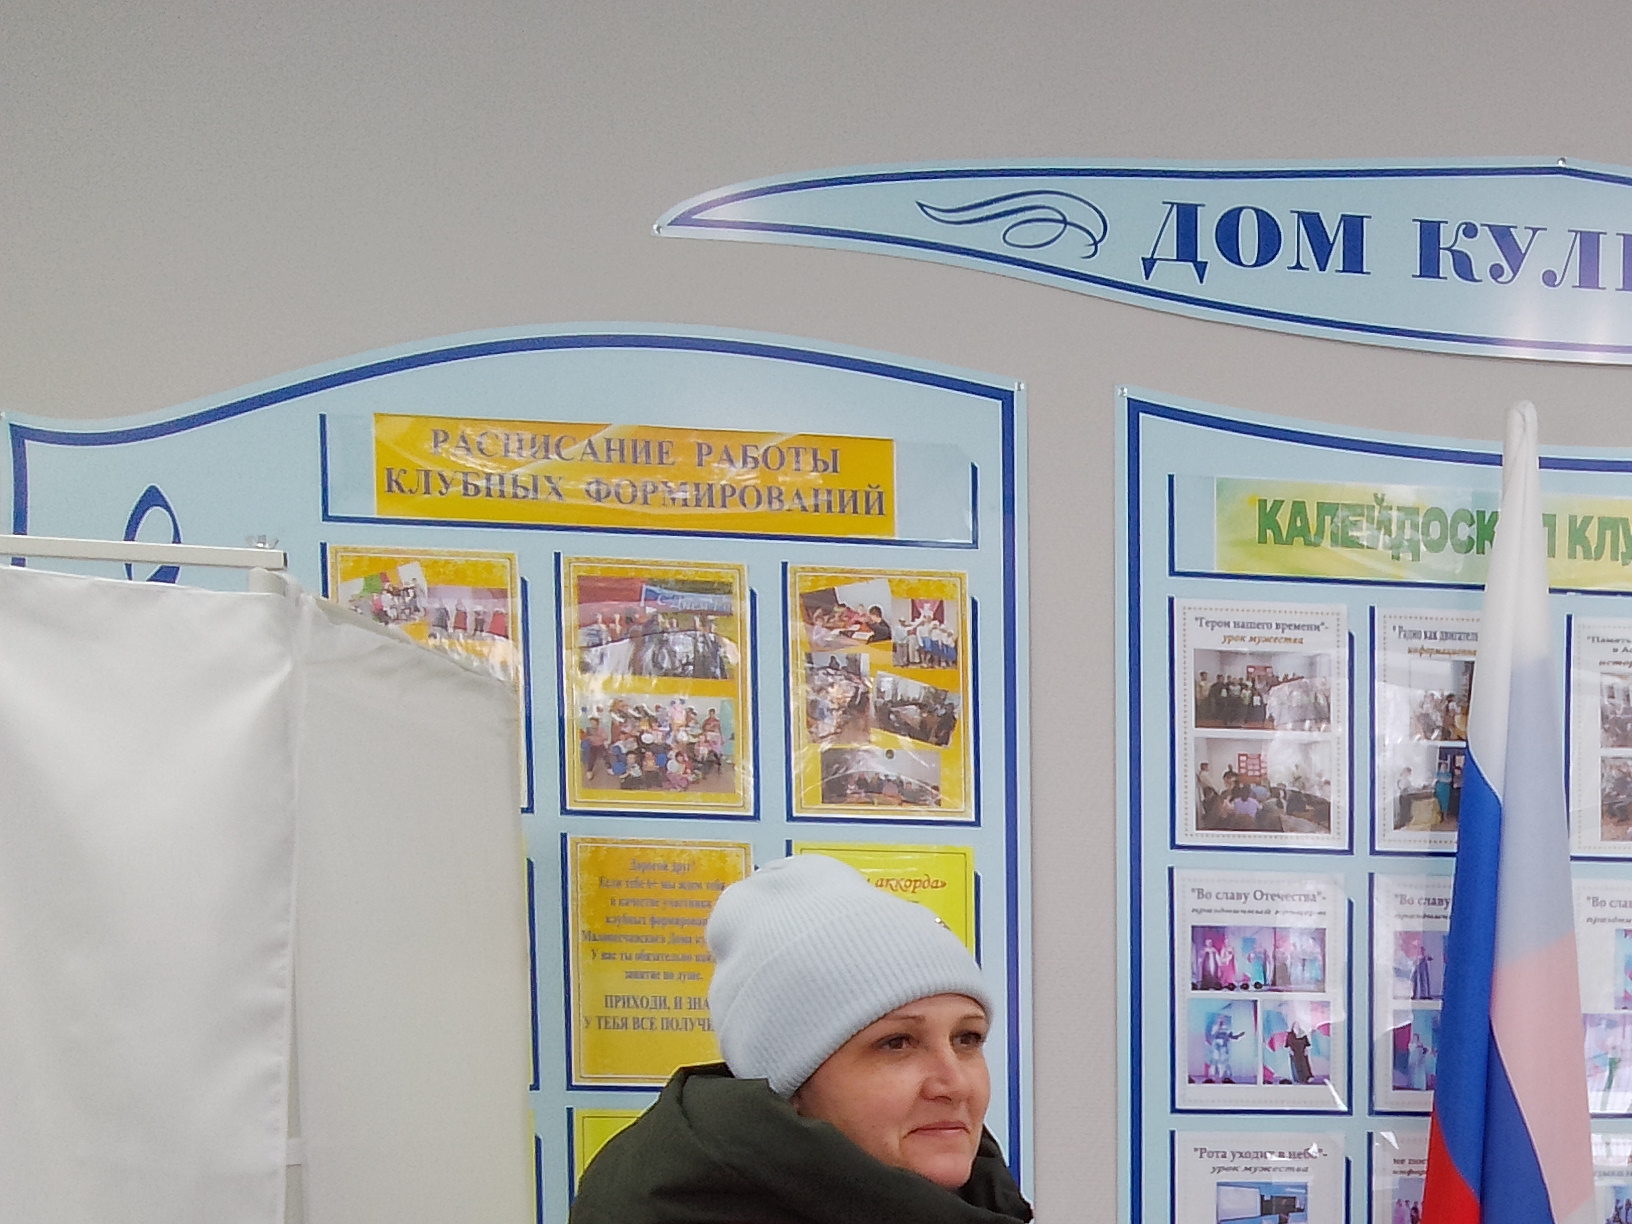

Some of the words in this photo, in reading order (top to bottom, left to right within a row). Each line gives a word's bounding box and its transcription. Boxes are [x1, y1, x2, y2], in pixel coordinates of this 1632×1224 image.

[1140, 200, 1370, 283] ДОМ
[431, 428, 675, 466] РАСПИСАНИЕ
[695, 442, 840, 473] РАБОТЫ
[384, 468, 563, 501] КЛУБНЫХ
[586, 477, 885, 518] ФОРМИРОВАНИЙ
[1257, 494, 1556, 562] КАЛЕЙДОСКП
[1233, 620, 1272, 630] нашего
[596, 1015, 629, 1030] ТЕБЯ
[687, 996, 711, 1010] ЗНА
